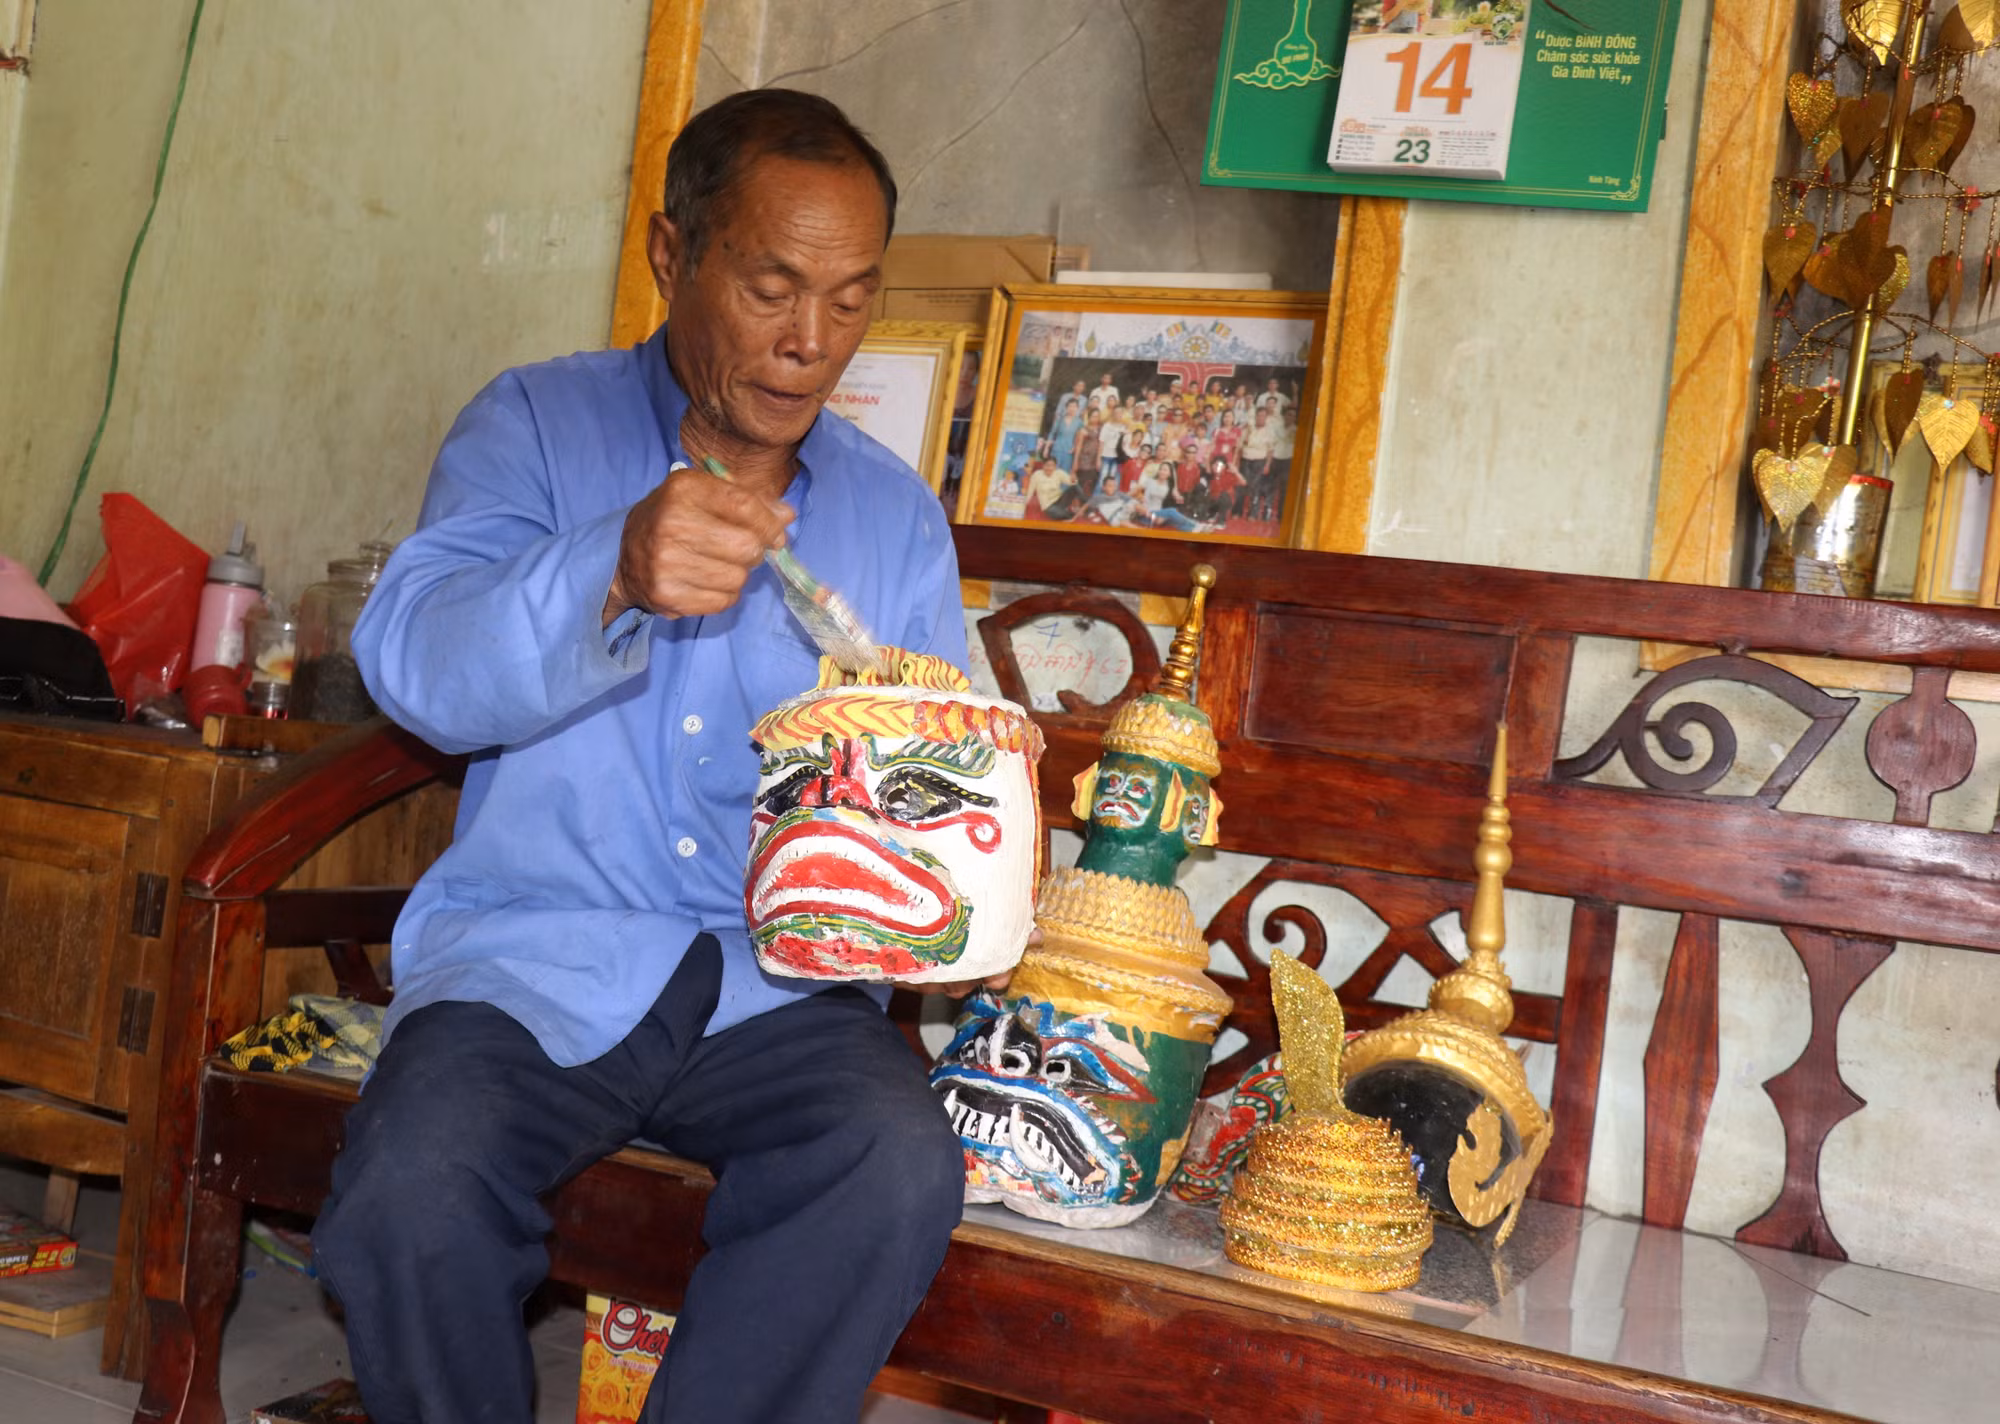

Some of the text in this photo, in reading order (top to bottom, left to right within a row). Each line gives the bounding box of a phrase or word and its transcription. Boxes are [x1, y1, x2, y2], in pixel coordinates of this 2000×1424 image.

[1569, 50, 1589, 64] sóc
[1386, 42, 1472, 114] 14
[1552, 65, 1568, 78] Gia
[1394, 139, 1431, 164] 23
